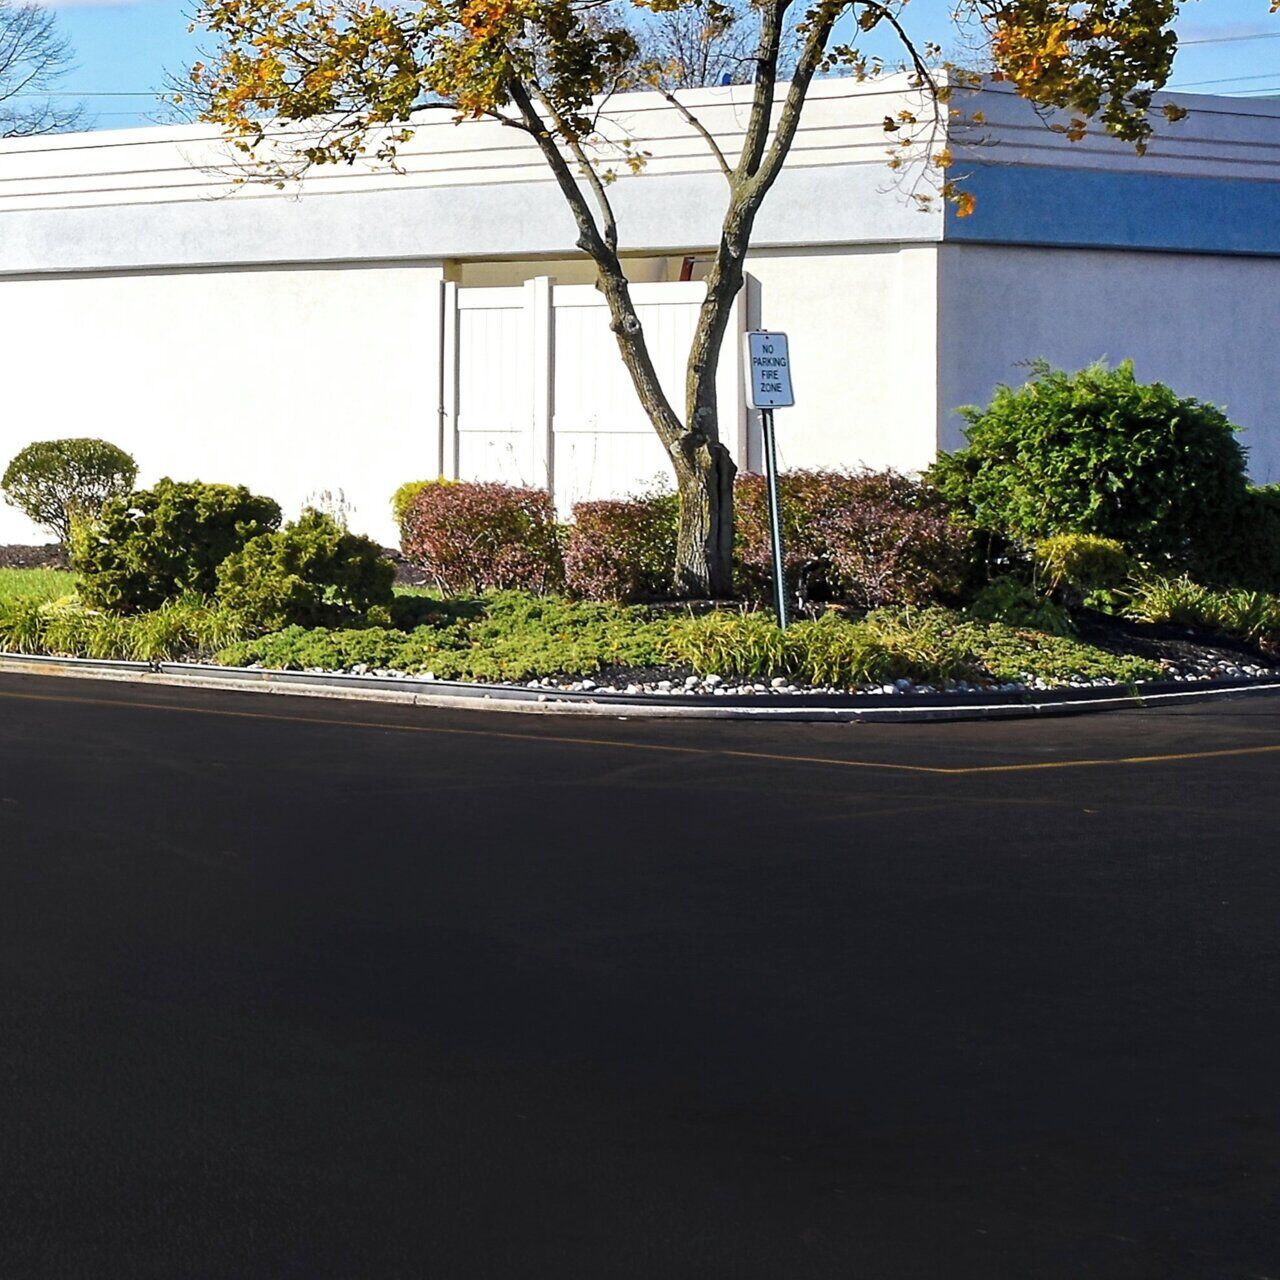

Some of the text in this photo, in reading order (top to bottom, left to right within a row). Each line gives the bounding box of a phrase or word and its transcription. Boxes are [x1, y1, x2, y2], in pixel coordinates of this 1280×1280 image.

[762, 344, 774, 354] NO
[753, 357, 786, 367] PARKING
[761, 370, 779, 380] FIRE
[760, 383, 782, 392] ZONE
